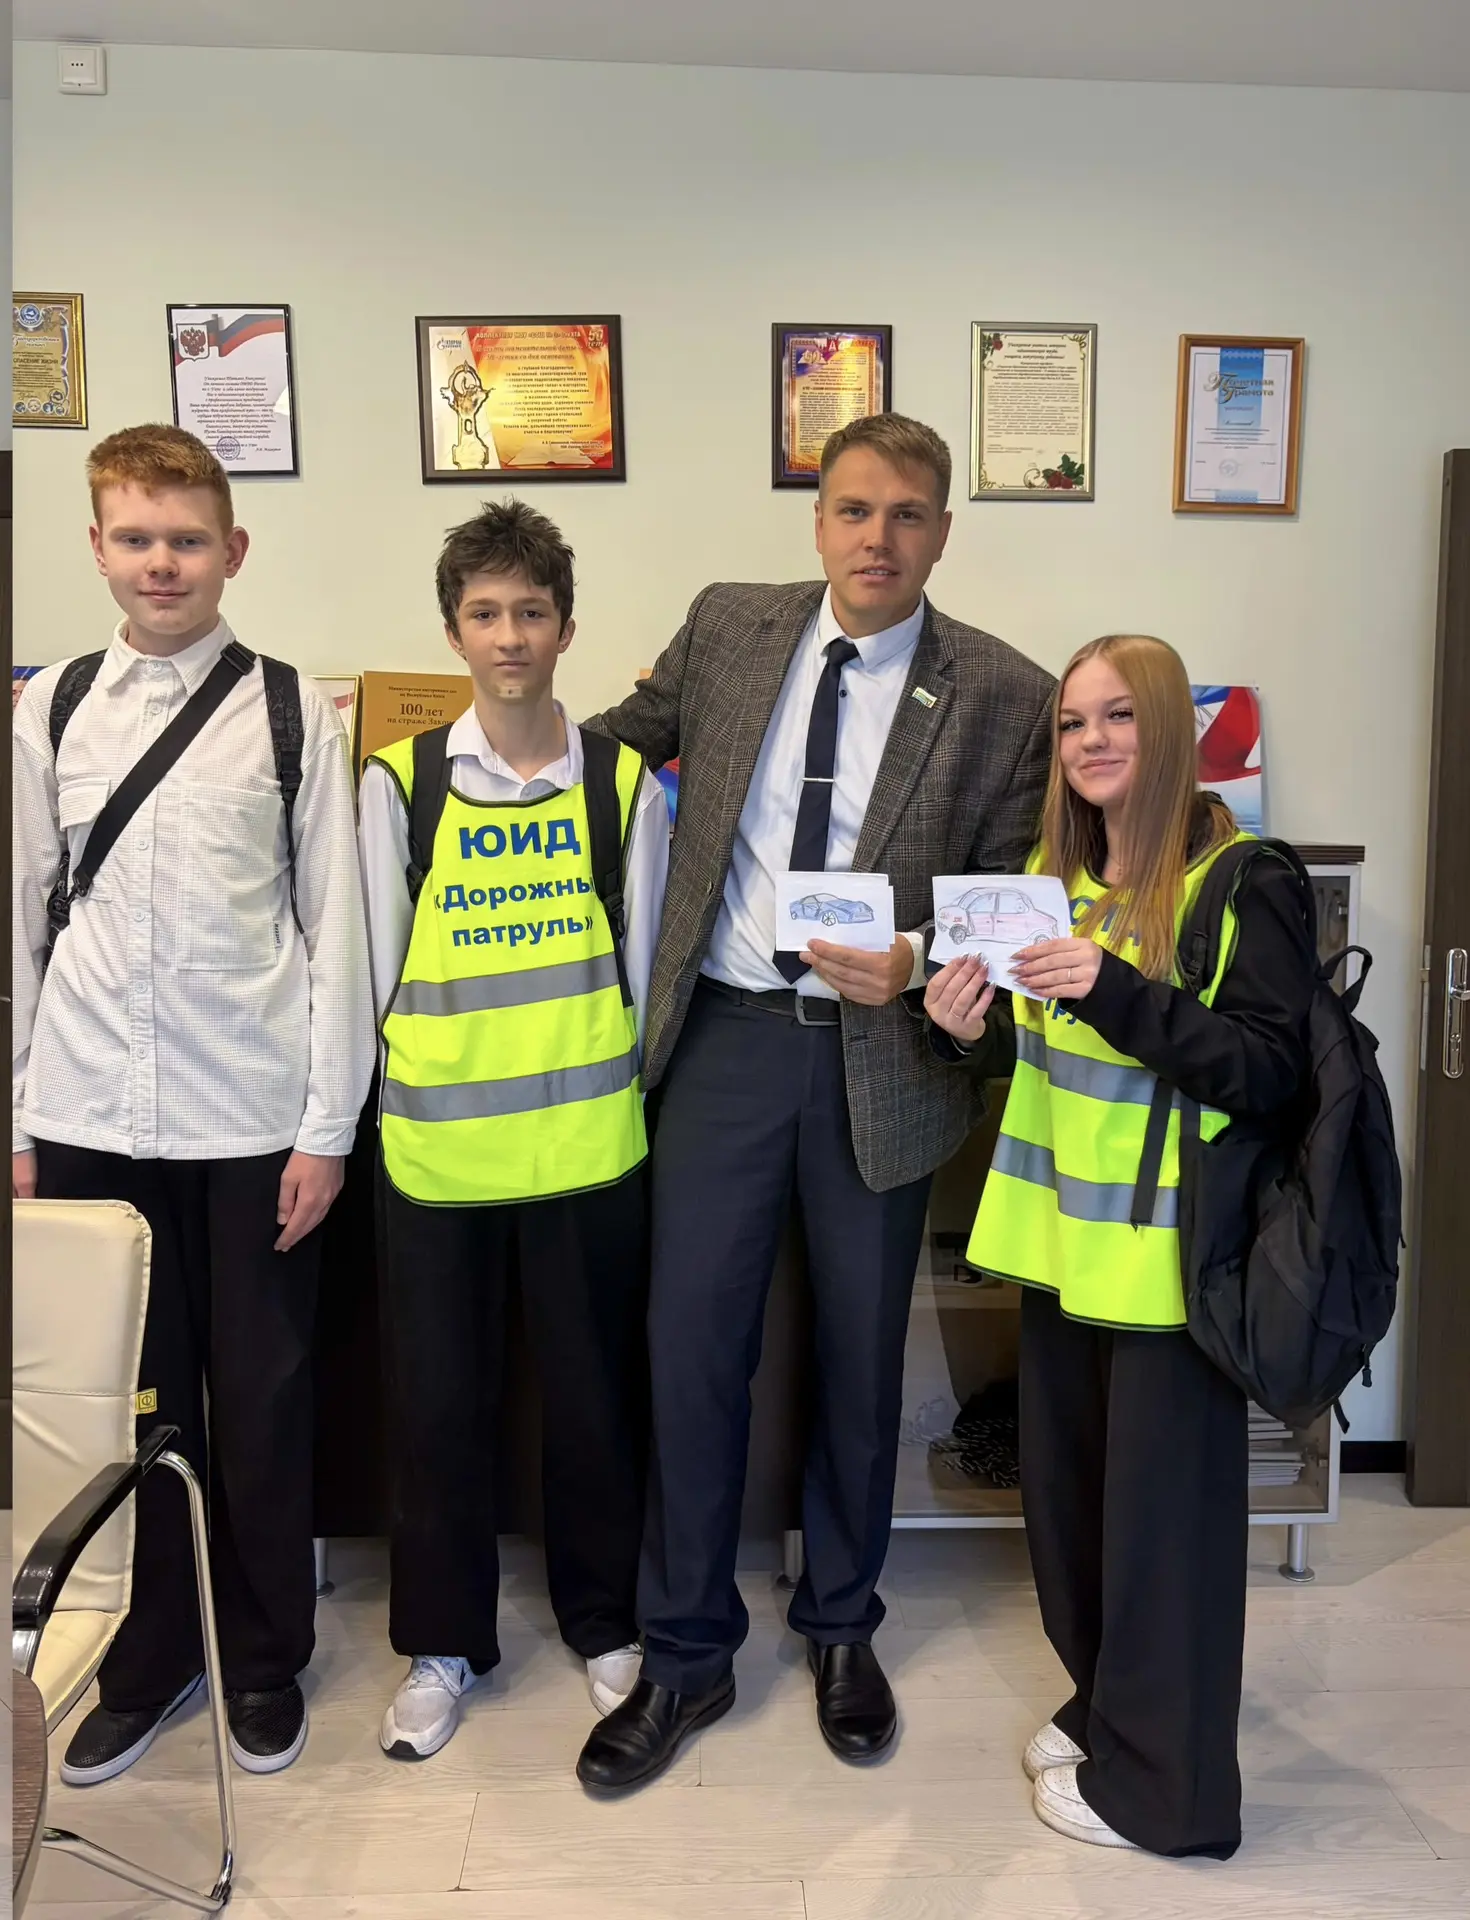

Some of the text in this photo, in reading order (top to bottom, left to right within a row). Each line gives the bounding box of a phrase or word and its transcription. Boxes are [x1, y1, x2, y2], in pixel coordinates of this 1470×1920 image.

[400, 703, 444, 716] 100 лет
[428, 718, 455, 726] Закон
[459, 818, 582, 859] ЮИД
[452, 916, 593, 947] патруль»
